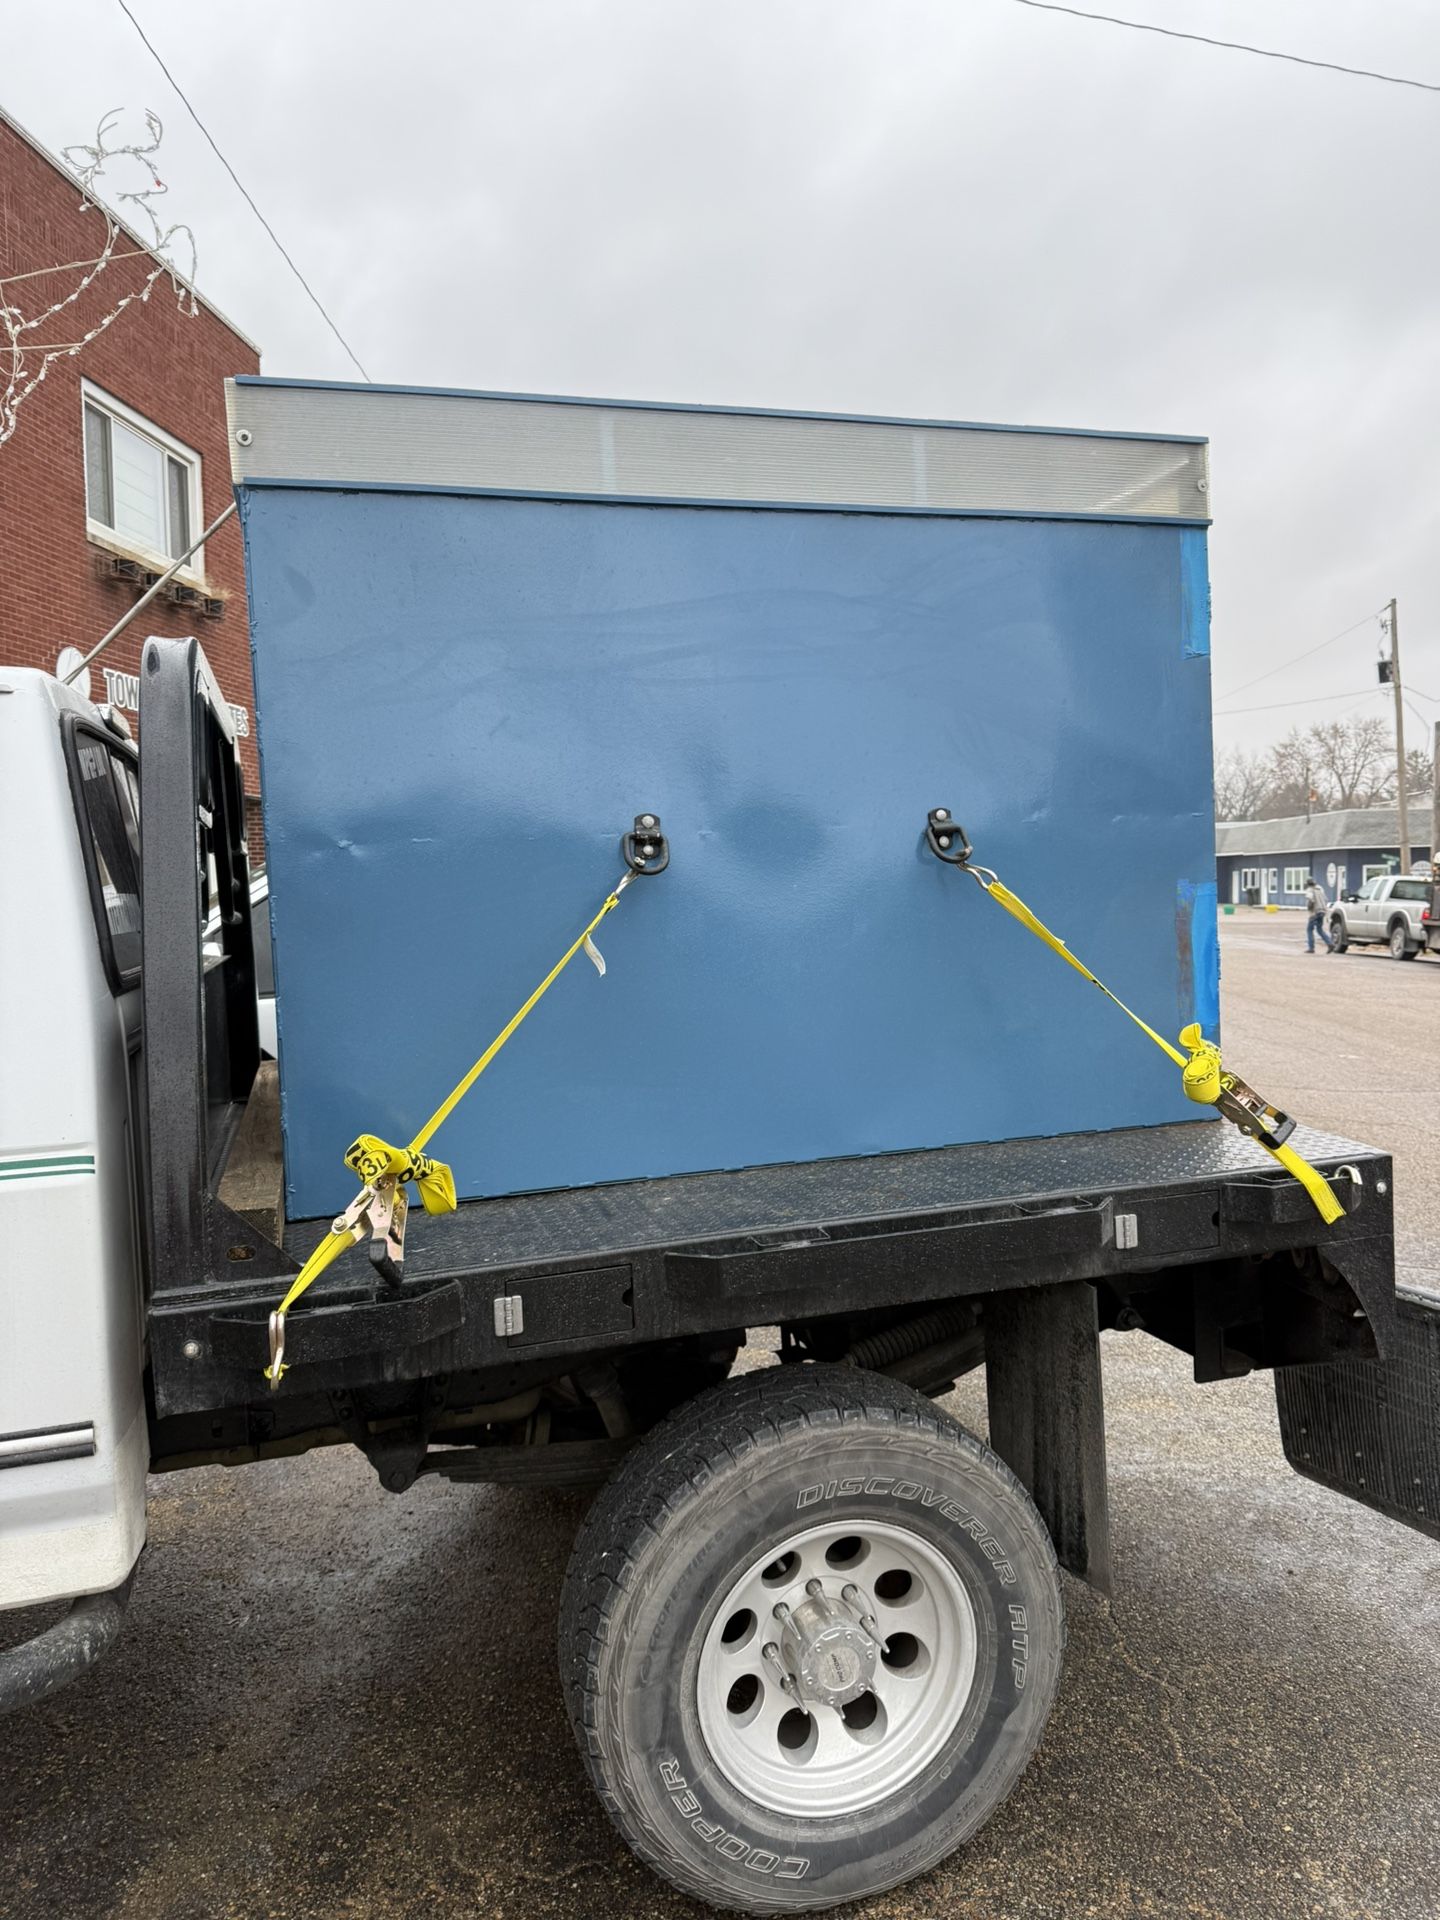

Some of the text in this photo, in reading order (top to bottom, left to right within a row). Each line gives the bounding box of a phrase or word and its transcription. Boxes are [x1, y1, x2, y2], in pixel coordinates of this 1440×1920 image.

[796, 1477, 1029, 1690] DISCOVERER ATP
[659, 1759, 810, 1879] COOPER
